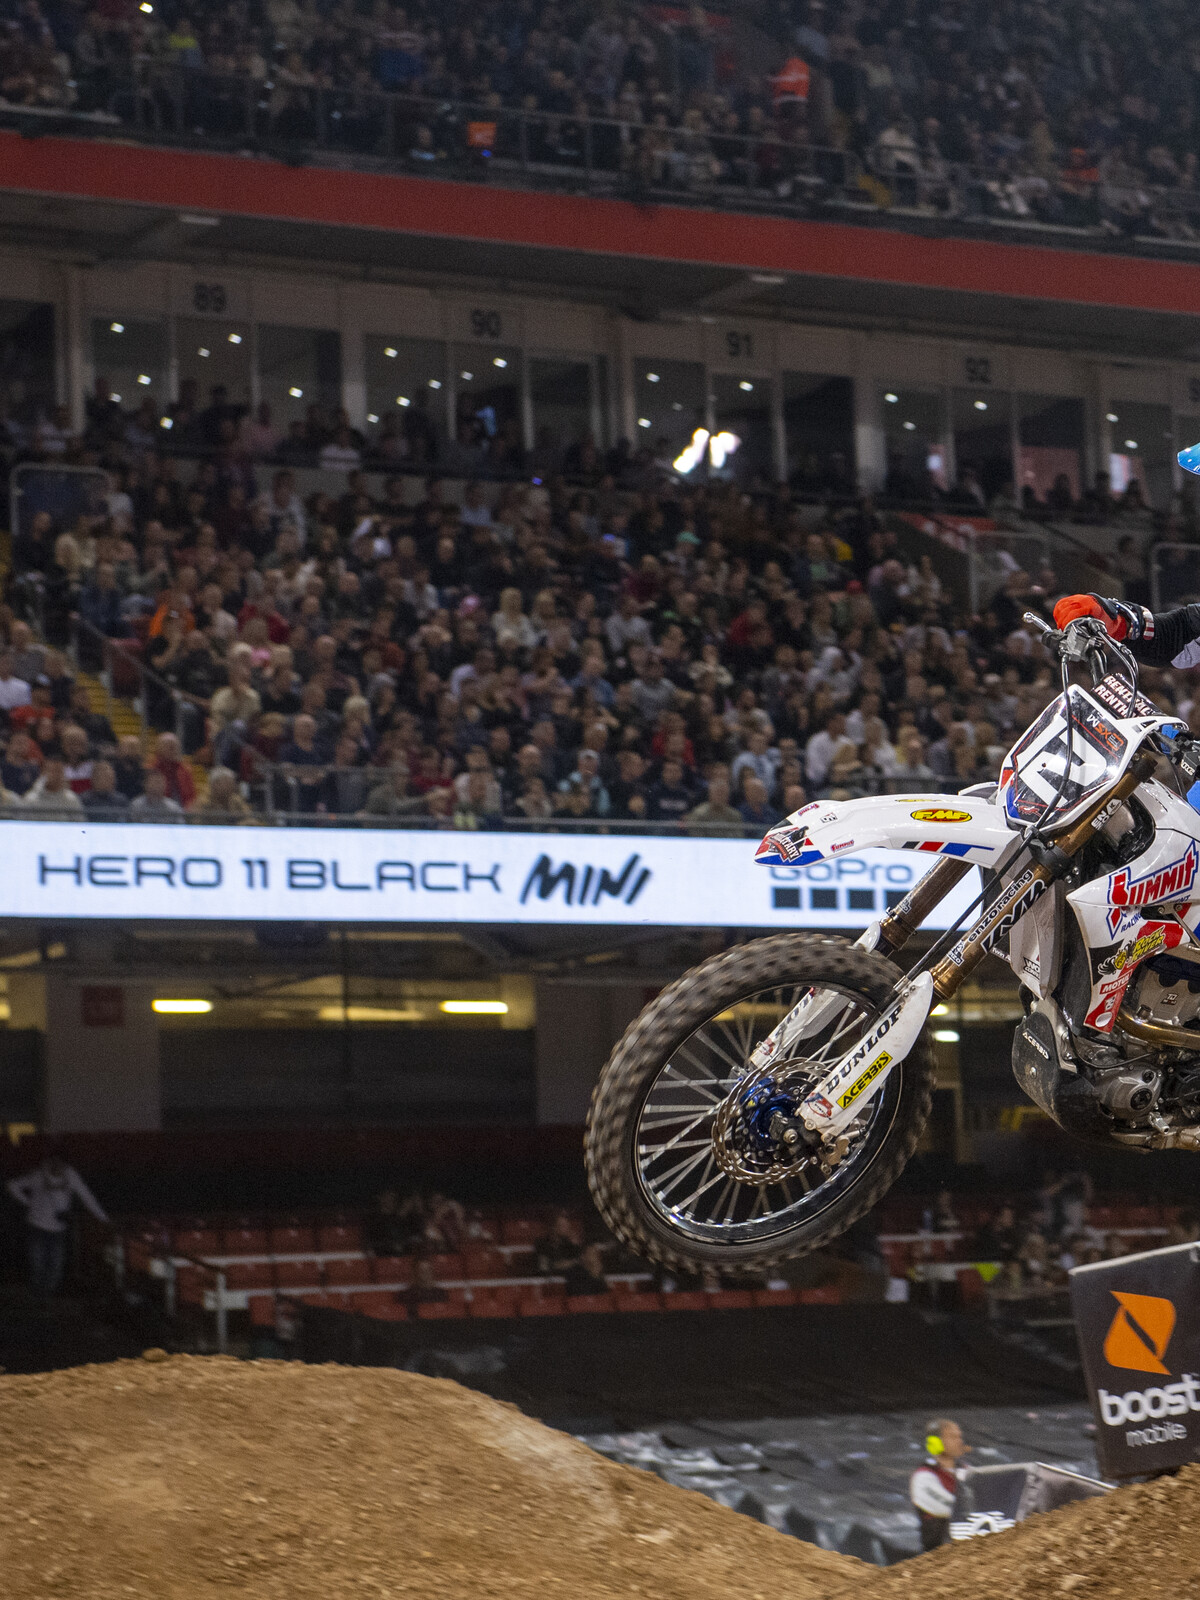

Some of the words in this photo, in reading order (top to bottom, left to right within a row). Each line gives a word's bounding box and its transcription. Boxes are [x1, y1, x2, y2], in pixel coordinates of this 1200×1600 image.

[471, 309, 502, 338] 90
[726, 331, 754, 357] 91
[1103, 675, 1155, 717] RENTAL
[913, 809, 970, 821] FMF
[38, 854, 223, 888] HERO
[240, 857, 270, 889] 11
[287, 858, 502, 893] BLACK
[518, 852, 653, 906] MINI
[769, 857, 914, 884] GoPro
[826, 1004, 902, 1095] DUNLOP
[1125, 1421, 1188, 1448] mobile
